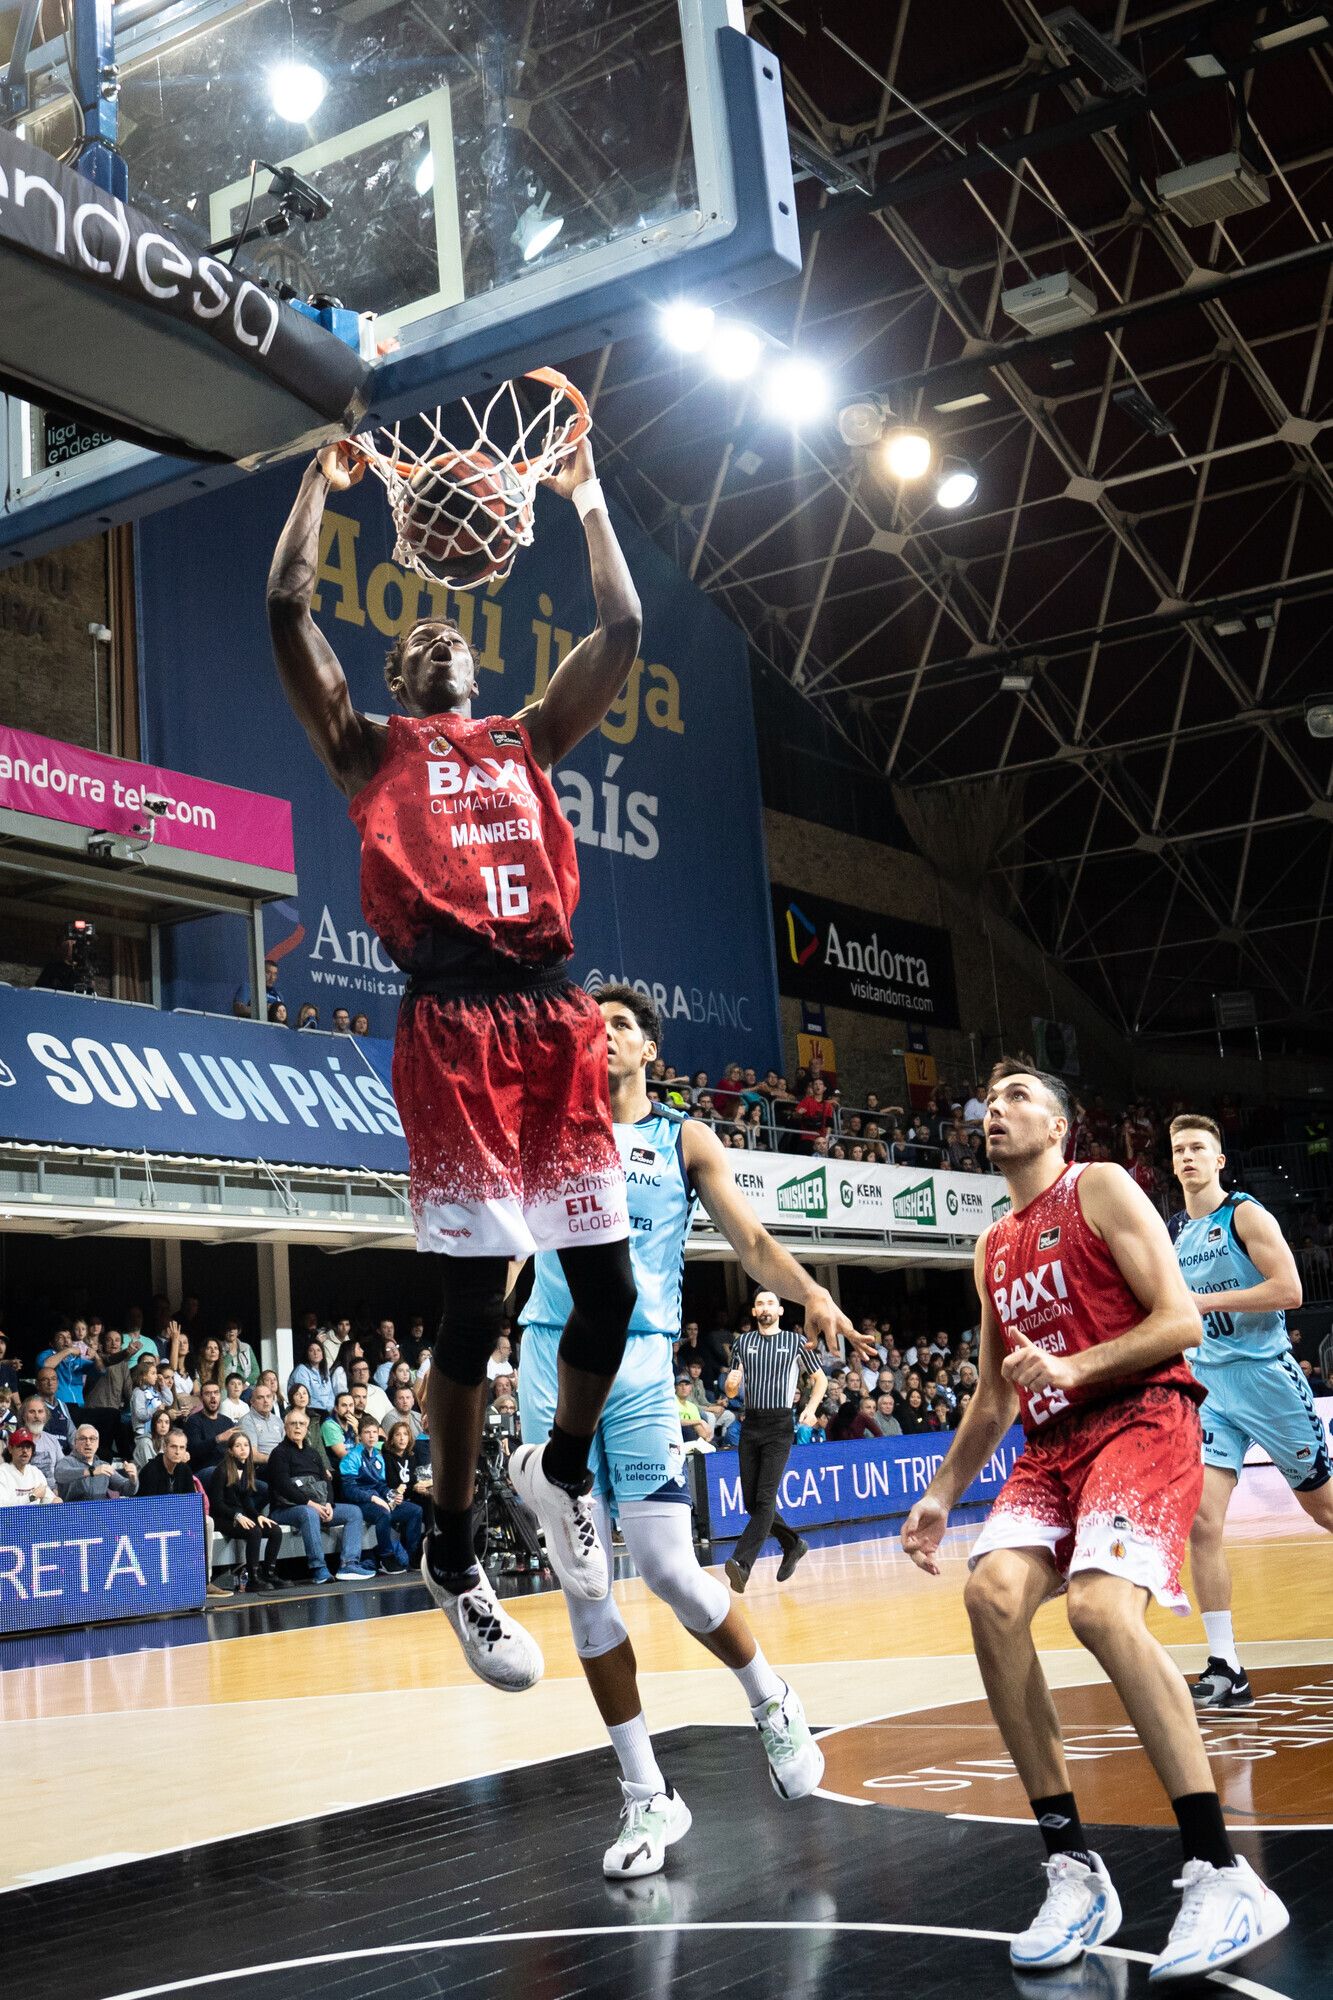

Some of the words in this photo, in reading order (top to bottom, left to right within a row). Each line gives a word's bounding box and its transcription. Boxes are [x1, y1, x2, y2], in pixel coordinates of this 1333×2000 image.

[0, 160, 279, 356] ndesa
[47, 423, 77, 446] liga
[525, 593, 685, 745] jga
[0, 755, 105, 803] andorra
[112, 780, 216, 830] telcom
[546, 753, 660, 861] aís
[451, 818, 543, 848] MANRESA
[480, 864, 530, 918] 16
[824, 922, 930, 988] Andorra
[609, 973, 752, 1031] RABANC
[851, 978, 934, 1012] visitandorra.com
[26, 1032, 197, 1116] SOM
[178, 1052, 291, 1125] UN
[269, 1056, 407, 1138] PAÍS
[735, 1172, 764, 1189] KERN
[778, 1177, 826, 1210] FINISHER
[857, 1184, 882, 1198] KERN
[566, 1194, 603, 1216] ETL
[894, 1187, 934, 1218] FINISHER
[961, 1193, 983, 1206] KERN
[1178, 1245, 1229, 1268] MORABANC
[993, 1259, 1068, 1323] BAXI
[1202, 1311, 1235, 1340] 30
[624, 1461, 666, 1472] andorra
[625, 1472, 669, 1482] telecom
[719, 1465, 845, 1517] MCA'T
[851, 1459, 889, 1499] UN
[980, 1447, 1007, 1483] EN
[0, 1530, 183, 1600] RETAT
